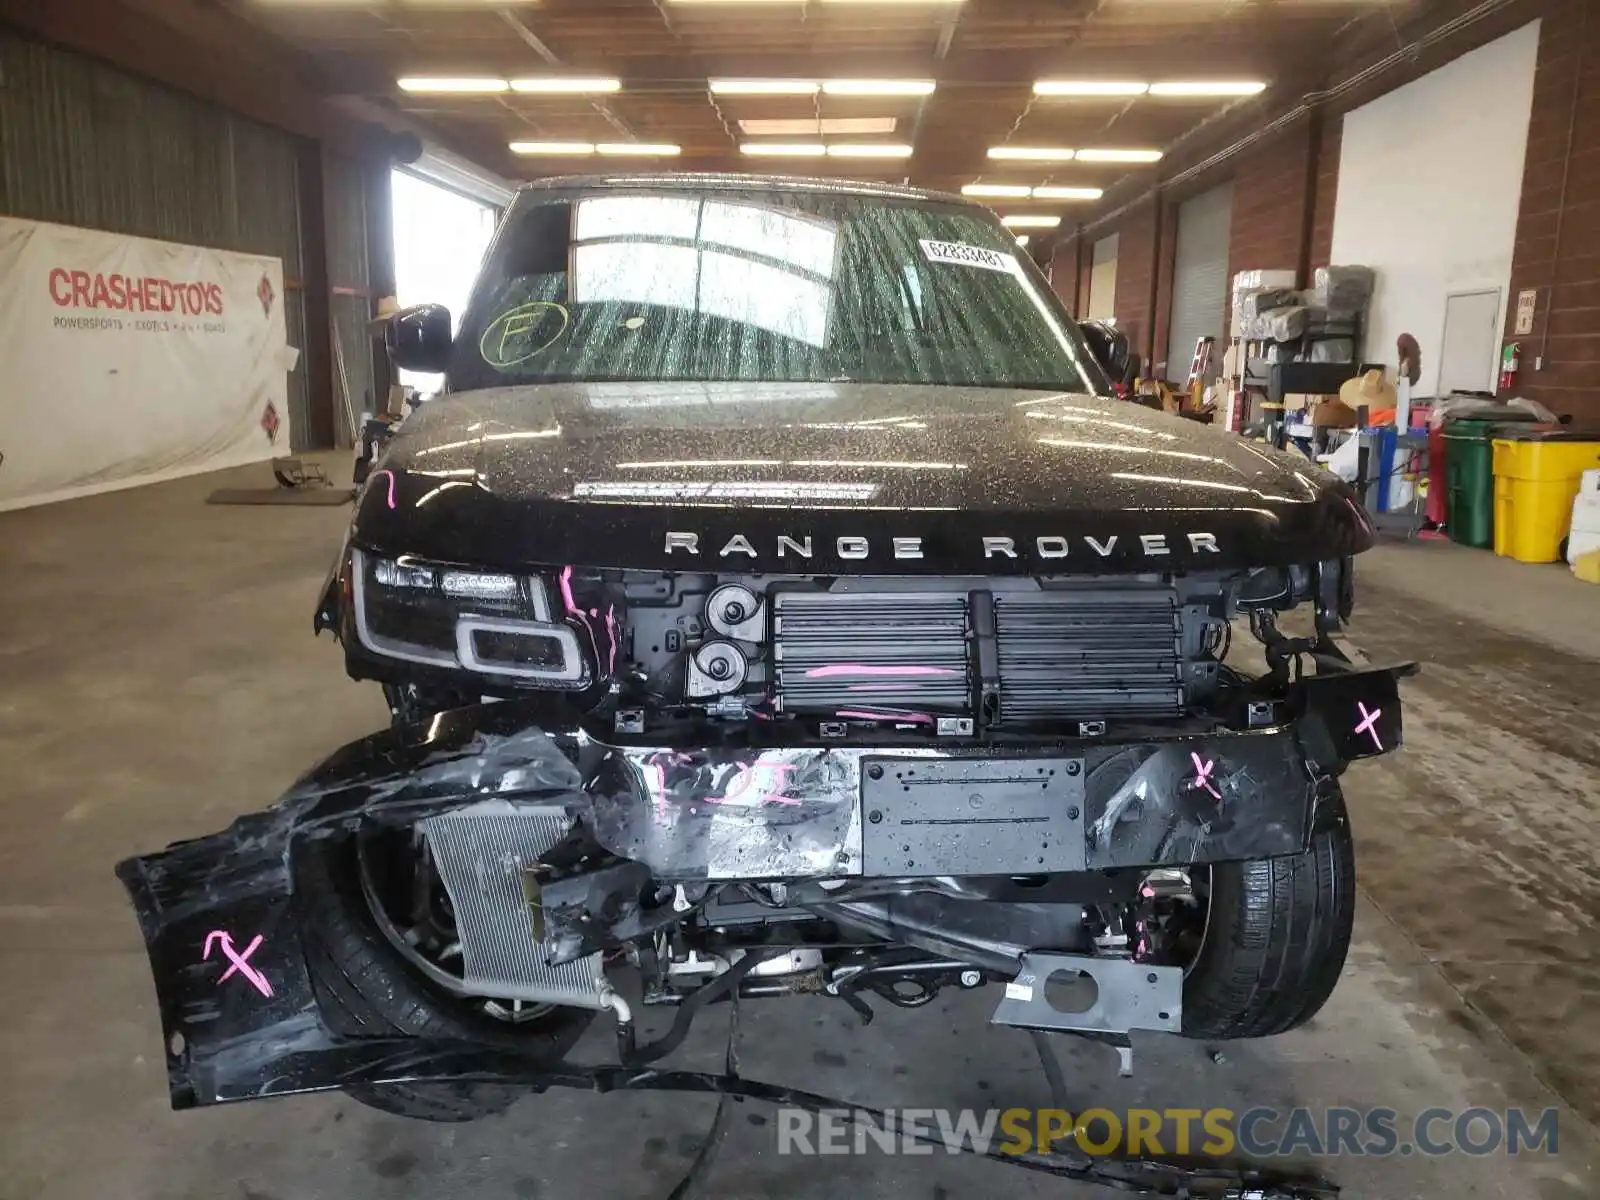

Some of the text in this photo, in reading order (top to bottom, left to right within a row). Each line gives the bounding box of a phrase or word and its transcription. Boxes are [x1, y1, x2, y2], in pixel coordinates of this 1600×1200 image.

[928, 241, 1006, 269] 62833481
[49, 267, 223, 316] CRASHEDTOYS
[53, 316, 123, 331] POWERSPORTS
[134, 319, 170, 333] EXOTICS
[664, 531, 1221, 560] RANGE ROVER
